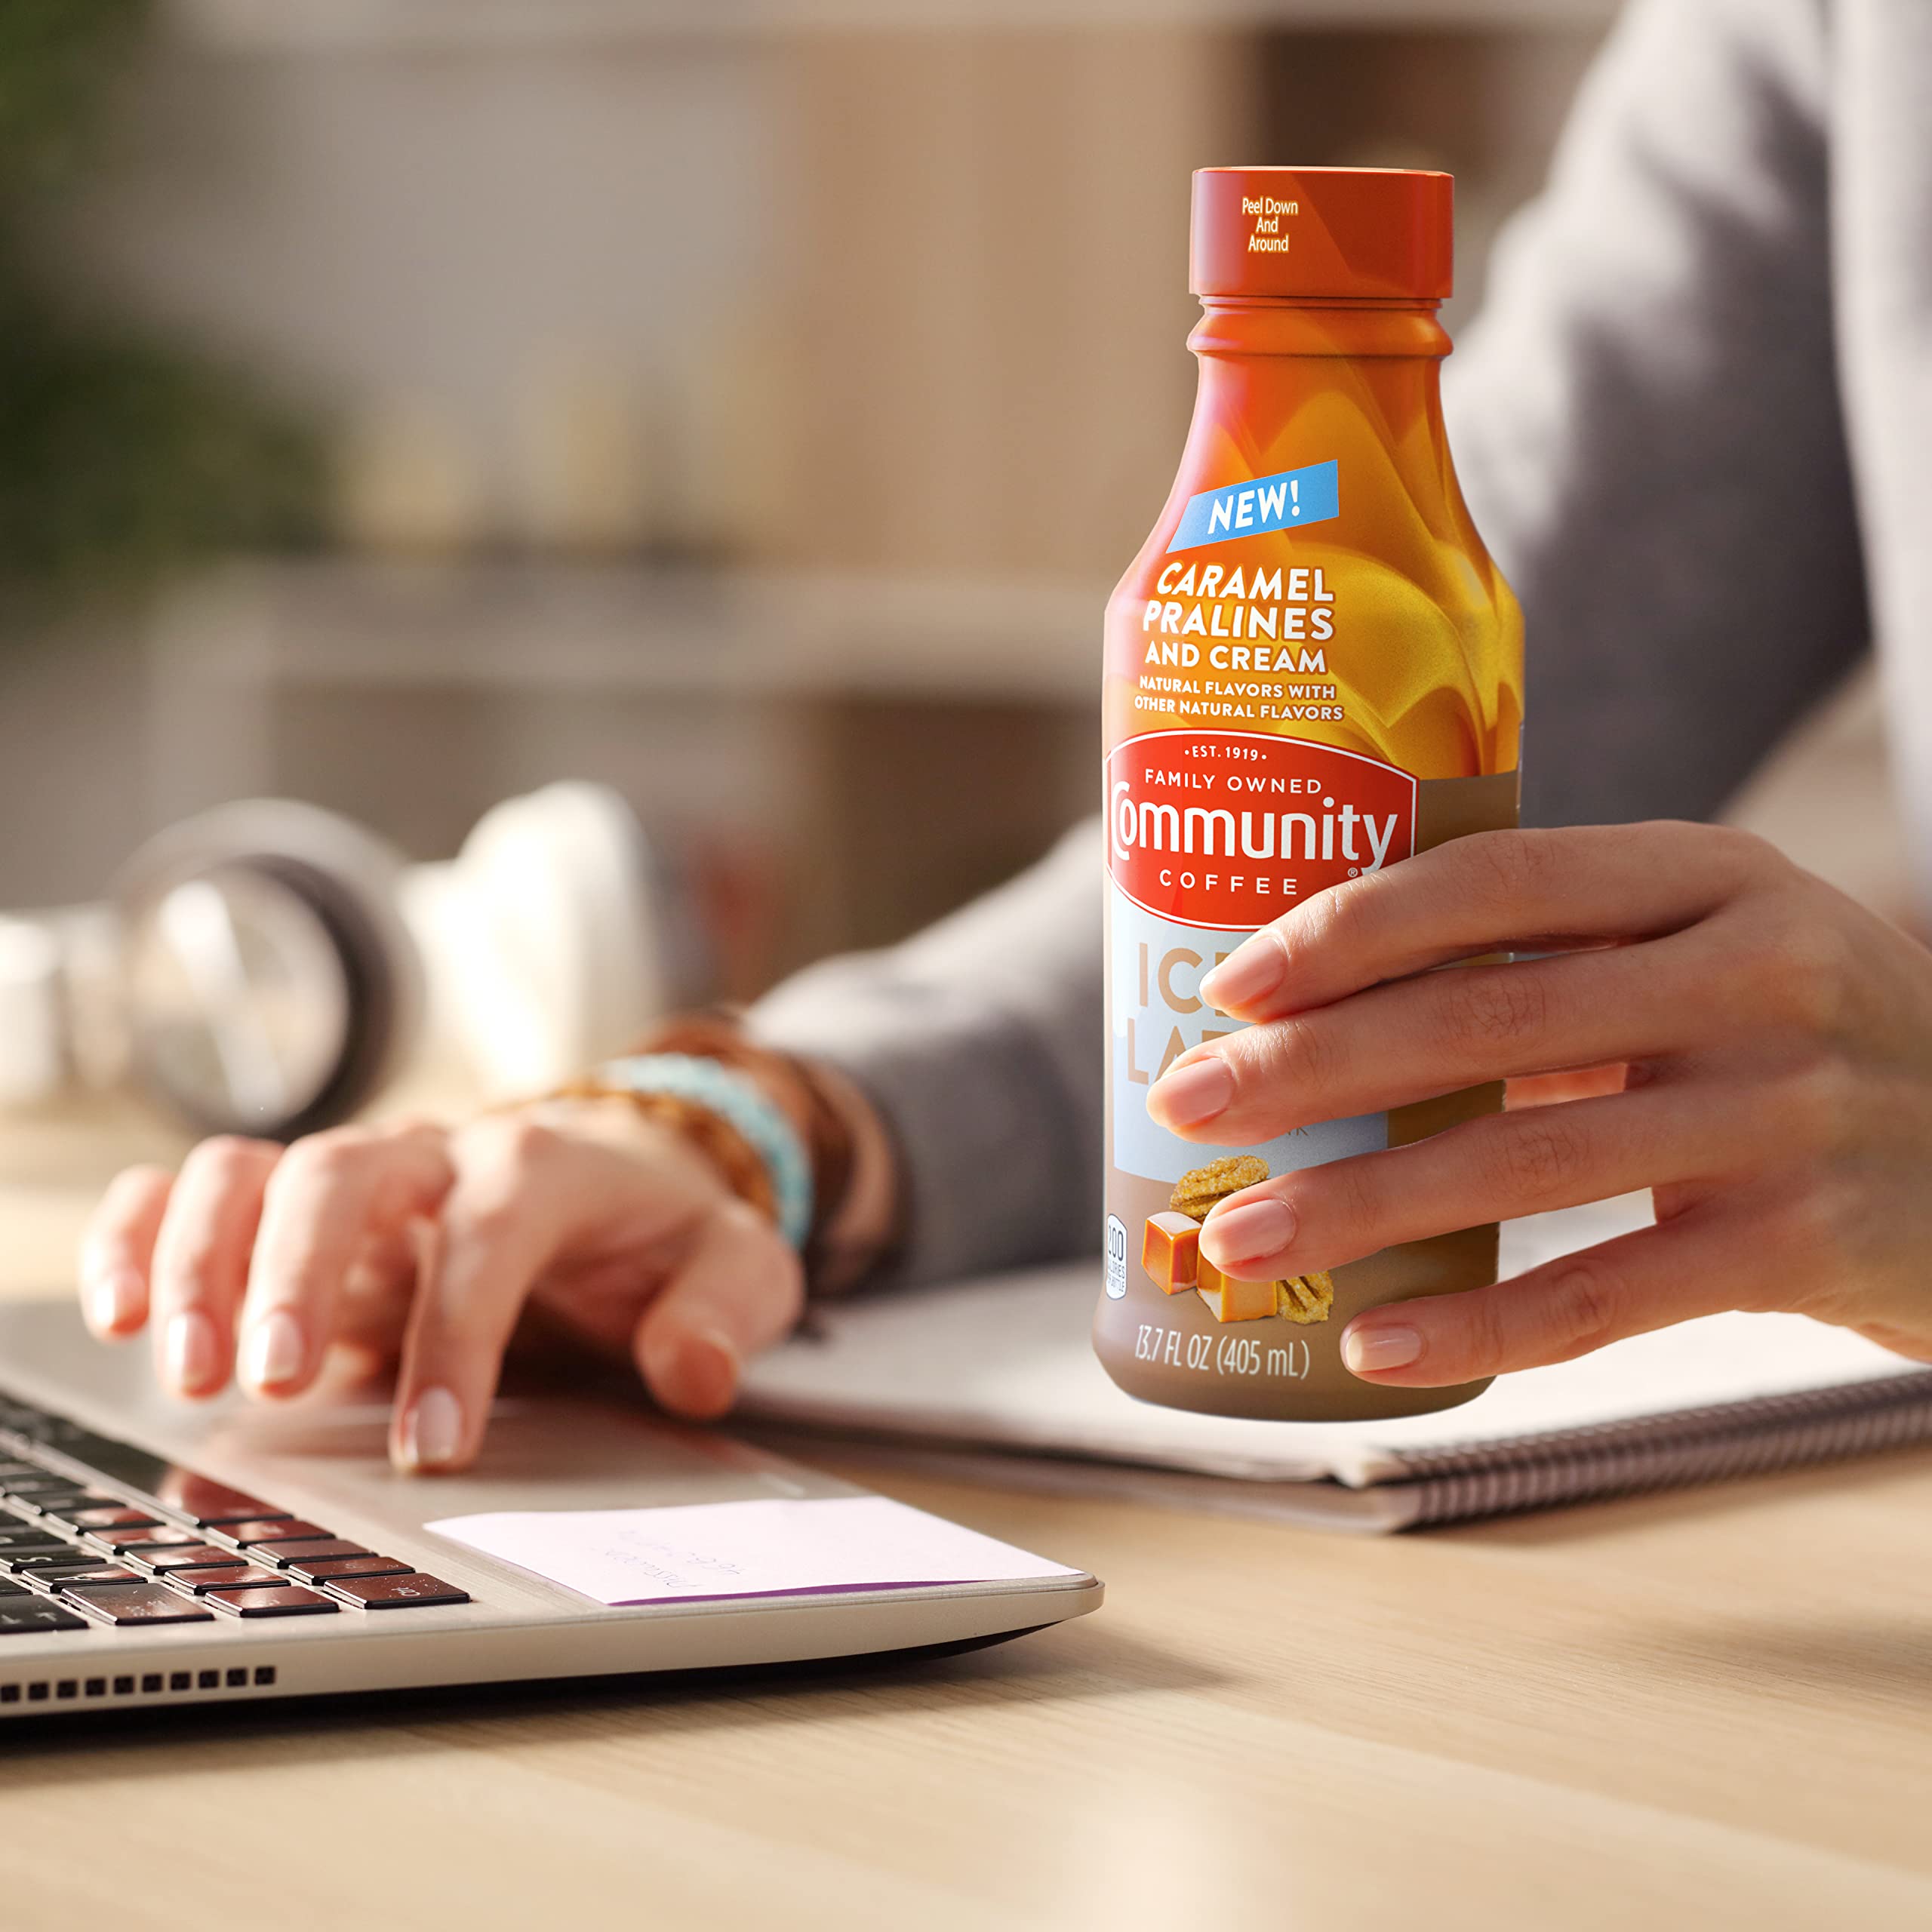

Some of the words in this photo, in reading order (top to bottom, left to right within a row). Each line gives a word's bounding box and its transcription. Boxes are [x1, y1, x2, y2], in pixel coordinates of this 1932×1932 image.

[1242, 198, 1263, 214] Peel
[1266, 198, 1298, 214] Down
[1256, 217, 1278, 232] And
[1248, 235, 1288, 251] Around
[1208, 479, 1300, 535] NEW!
[1157, 562, 1334, 601] CARAMEL
[1143, 600, 1333, 640] PRALINES
[1145, 641, 1200, 667] AND
[1210, 646, 1326, 672] CREAM
[1140, 675, 1200, 694] NATURAL
[1205, 681, 1283, 698] FLAVORS
[1289, 685, 1336, 699] WITH
[1134, 695, 1175, 713] OTHER
[1180, 700, 1254, 718] NATURAL
[1260, 706, 1343, 720] FLAVORS
[1146, 768, 1216, 789] FAMILY
[1227, 777, 1321, 794] OWNED
[1111, 781, 1398, 875] Community
[1160, 869, 1297, 896] COFFEE
[1135, 1324, 1164, 1361] 13.7
[1164, 1331, 1182, 1366] FL
[1187, 1334, 1213, 1371] OZ
[1217, 1336, 1261, 1376] (405
[1267, 1340, 1309, 1380] mL)
